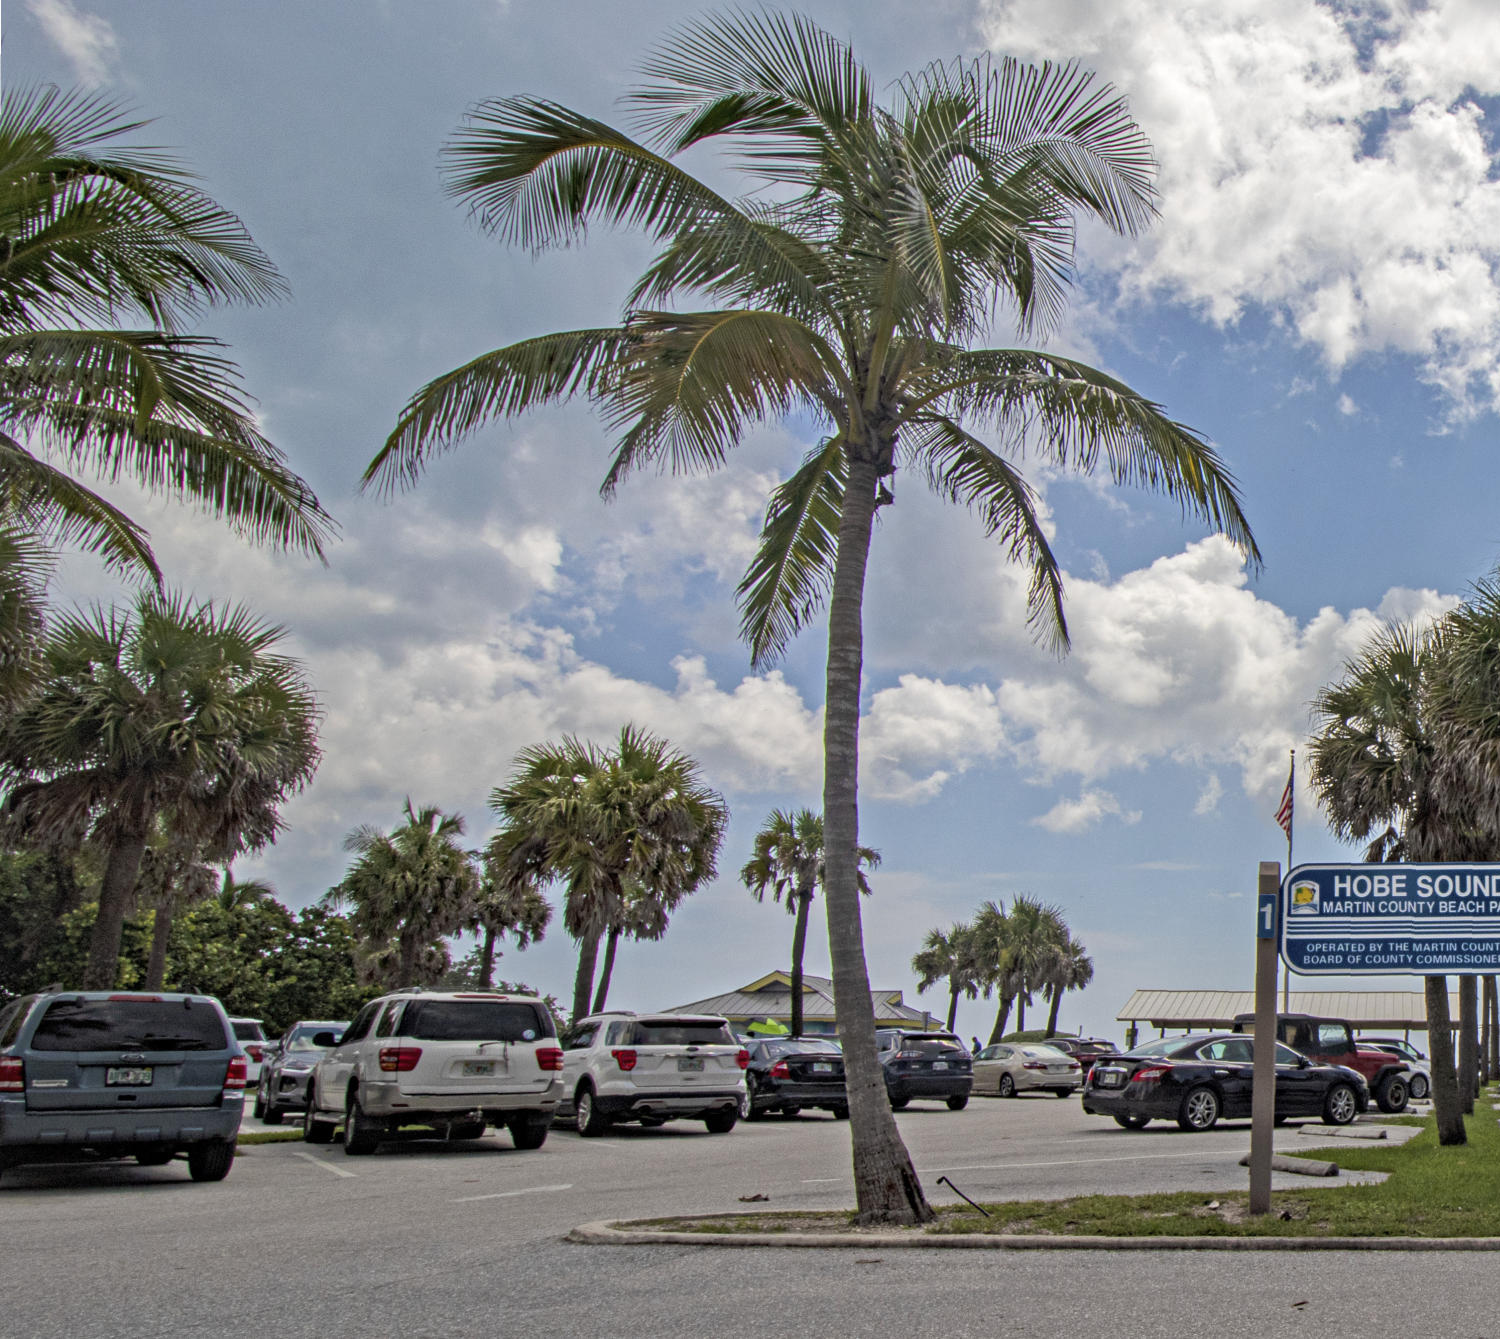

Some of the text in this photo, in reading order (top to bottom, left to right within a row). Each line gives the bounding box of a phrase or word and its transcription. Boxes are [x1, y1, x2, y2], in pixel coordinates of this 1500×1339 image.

[1334, 875, 1407, 897] HOBE
[1323, 901, 1375, 913] MARTIN
[1378, 900, 1435, 913] COUNTY
[1439, 900, 1485, 913] BEACH
[1260, 903, 1273, 930] 1
[1306, 943, 1366, 953] OPERATED
[1369, 943, 1383, 952] BY
[1389, 942, 1410, 952] THE
[1412, 942, 1458, 952] MARTIN
[1303, 954, 1343, 965] BOARD
[1347, 954, 1362, 964] OF
[1365, 954, 1414, 964] COUNTY
